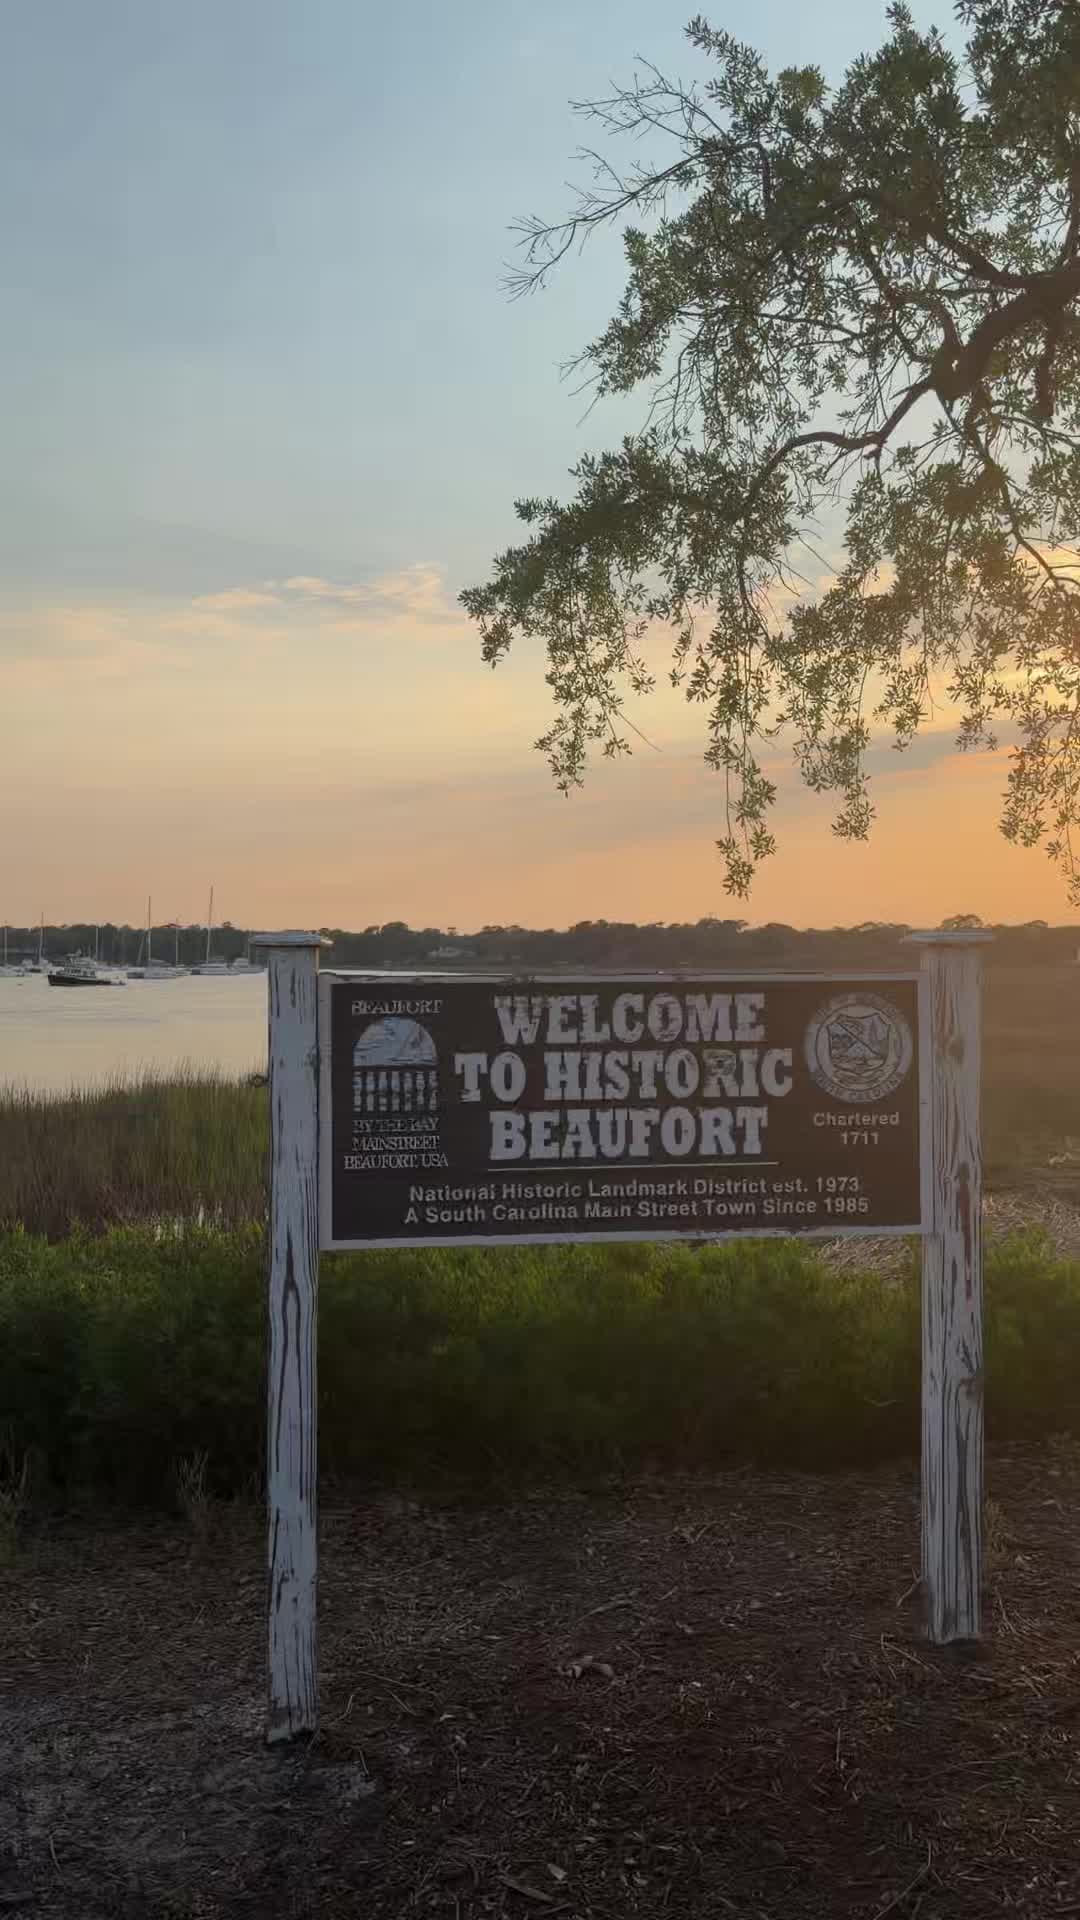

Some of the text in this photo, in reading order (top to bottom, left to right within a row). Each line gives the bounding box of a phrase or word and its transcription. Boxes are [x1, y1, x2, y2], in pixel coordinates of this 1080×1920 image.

[351, 999, 441, 1015] BEAUFORT
[494, 993, 766, 1044] WELCOME
[454, 1049, 793, 1102] TO HISTORIC
[813, 1111, 900, 1127] Chartered
[489, 1106, 769, 1160] BEAUFORT
[841, 1131, 880, 1145] 1711
[422, 1153, 449, 1168] USA
[409, 1176, 860, 1201] National Historic Landmark District est. 1973
[404, 1197, 869, 1224] A South Carolina Main Street Town Since 1985
